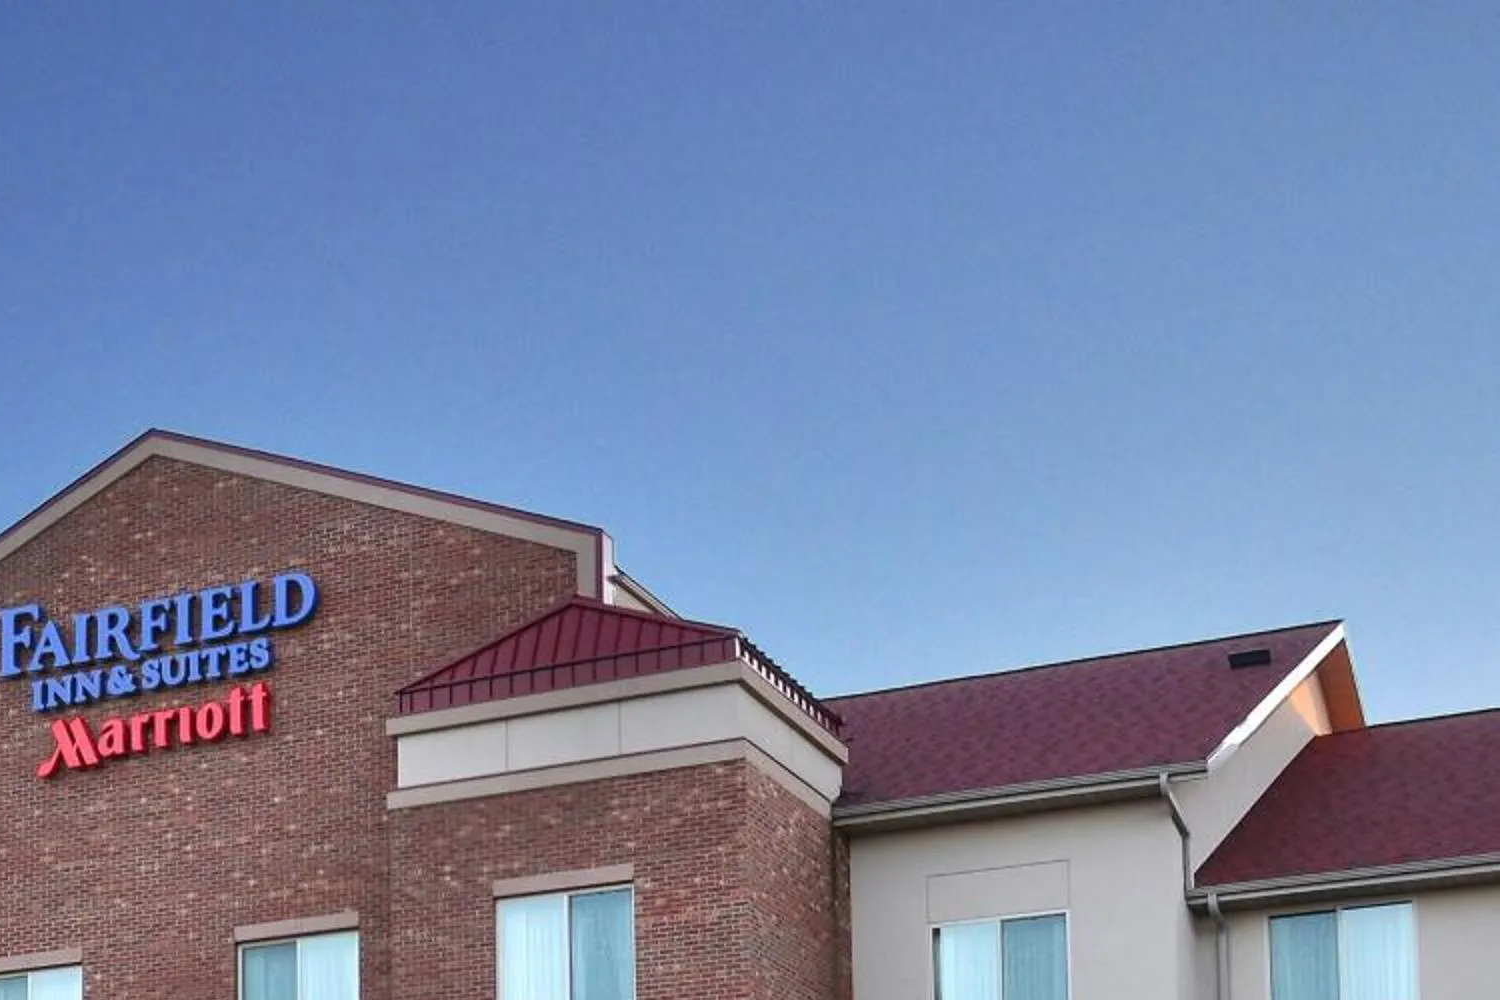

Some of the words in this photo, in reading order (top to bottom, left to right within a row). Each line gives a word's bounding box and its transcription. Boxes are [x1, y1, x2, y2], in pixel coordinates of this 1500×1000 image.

[31, 669, 102, 713] INN
[140, 636, 273, 692] SUITES
[36, 681, 270, 779] Marriott
